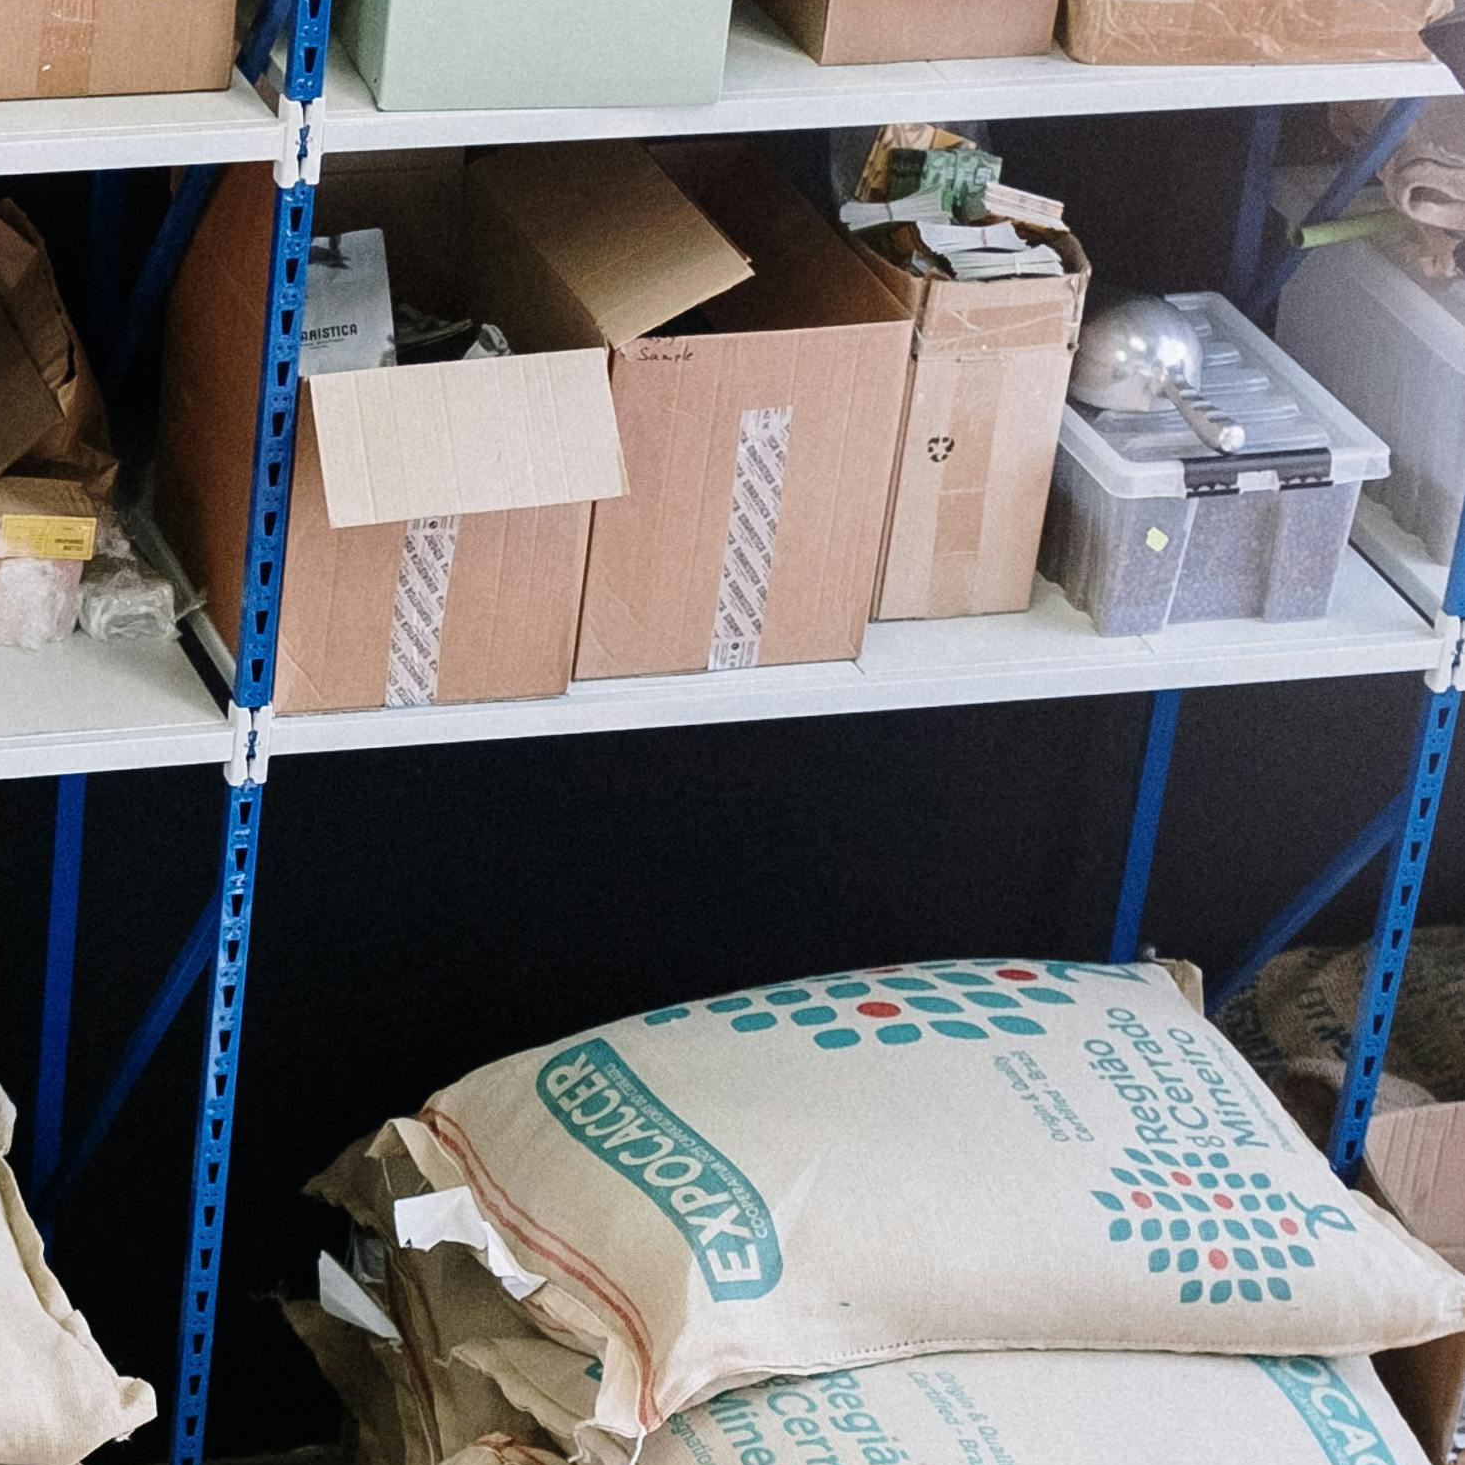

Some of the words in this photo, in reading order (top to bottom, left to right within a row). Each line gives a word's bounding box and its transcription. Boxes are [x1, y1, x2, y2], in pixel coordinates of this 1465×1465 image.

[637, 339, 694, 363] Sample
[1085, 1038, 1178, 1146] Região
[1106, 1006, 1209, 1131] Cerrado
[1167, 1027, 1270, 1148] Mineiro
[545, 1051, 763, 1283] EXPOCACCER
[906, 1370, 963, 1427] Certified
[934, 1370, 974, 1409] Origin
